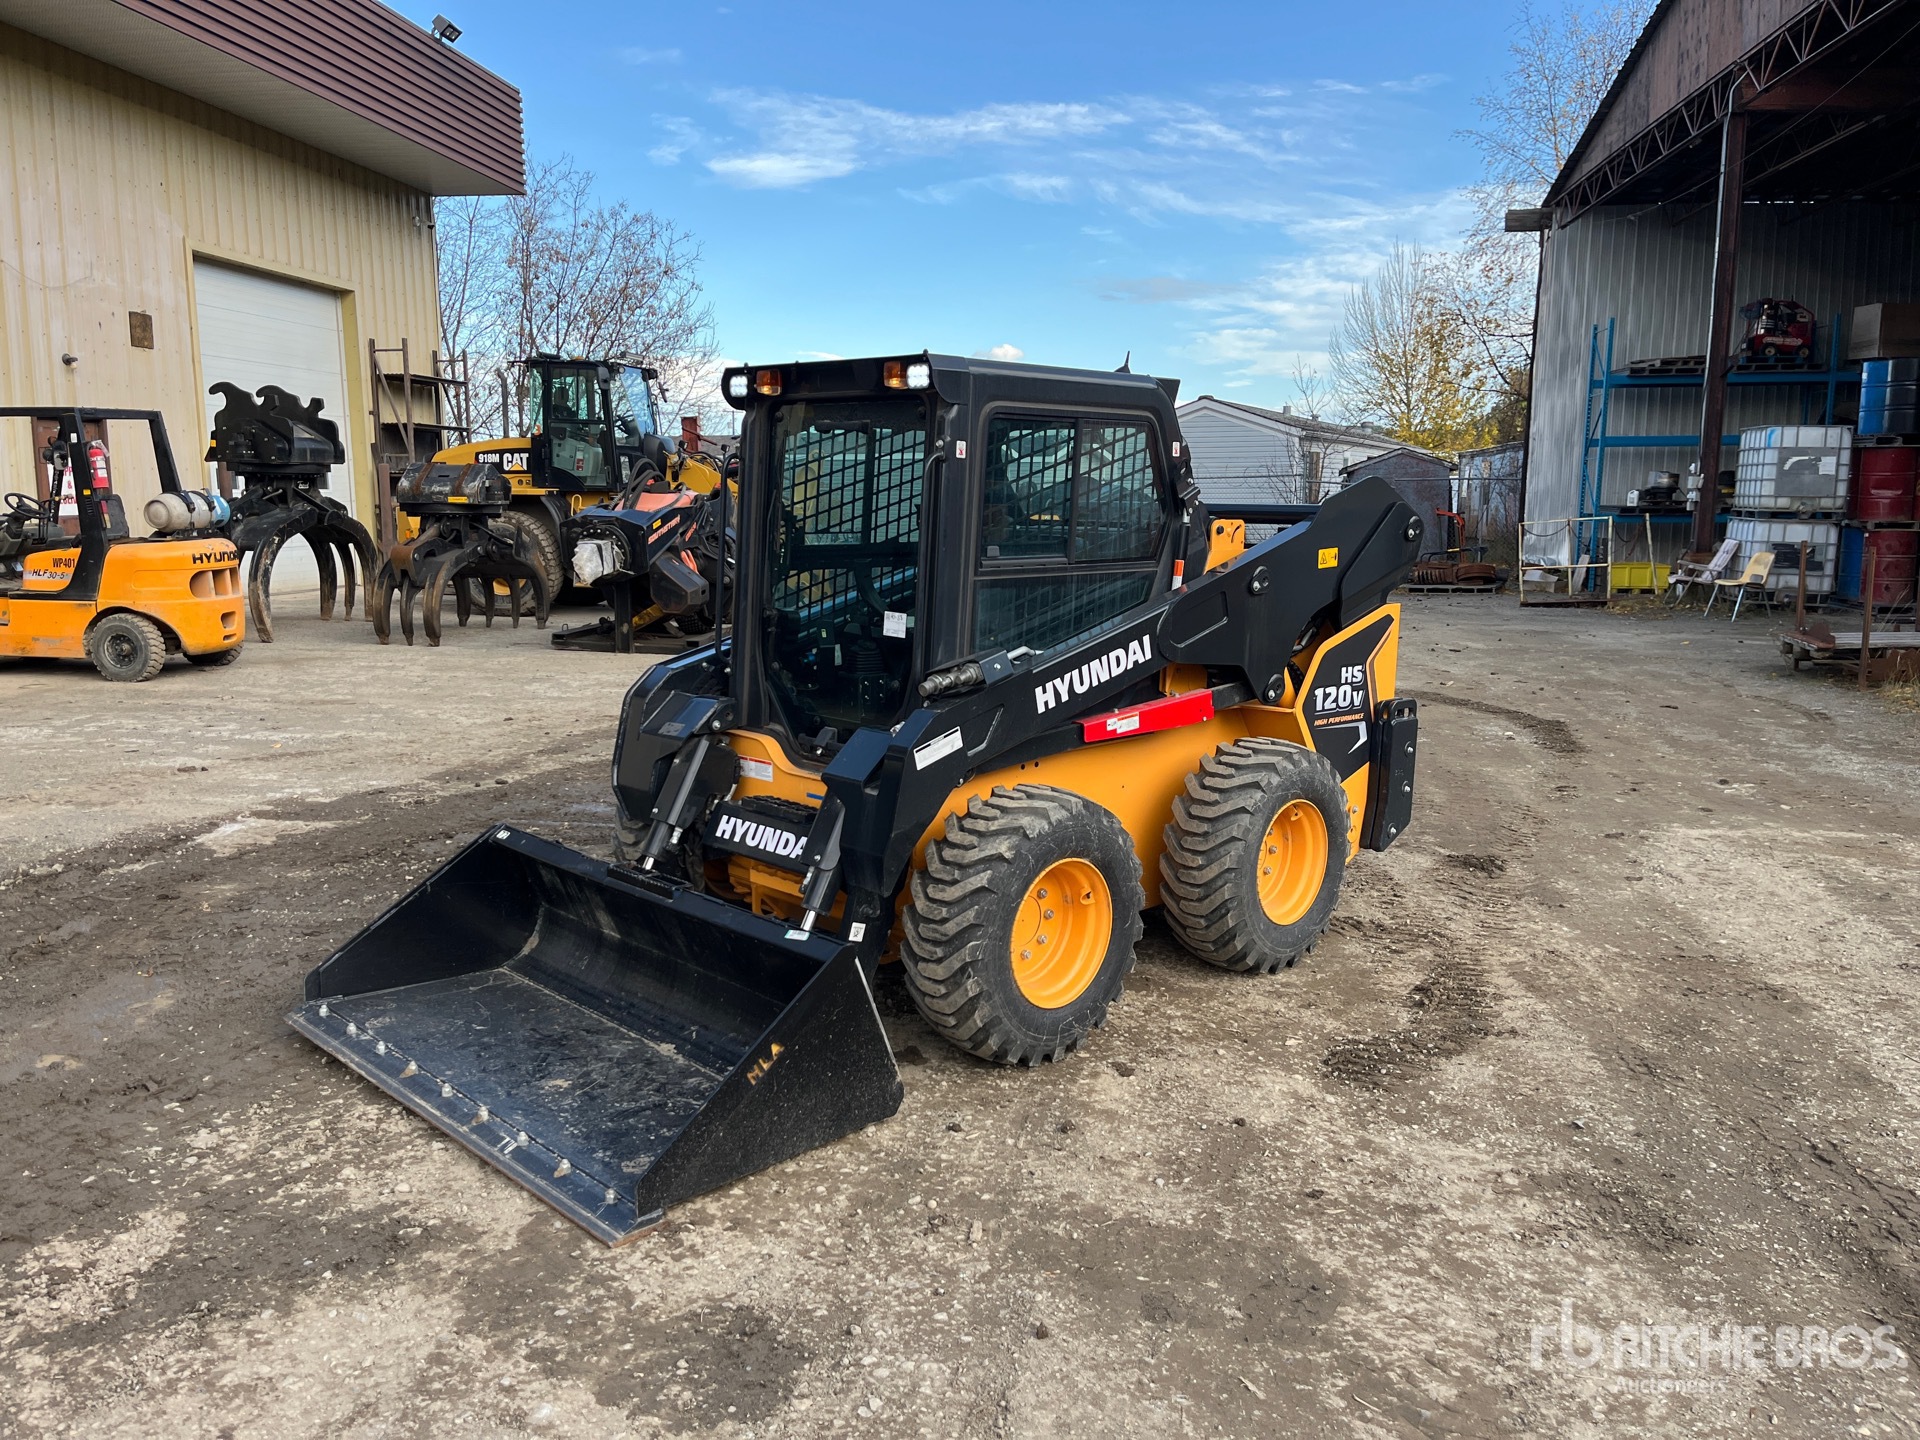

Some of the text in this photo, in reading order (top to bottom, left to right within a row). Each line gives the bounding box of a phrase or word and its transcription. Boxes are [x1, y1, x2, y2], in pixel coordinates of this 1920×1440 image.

[478, 453, 529, 471] 918M CAT
[53, 558, 75, 567] WP401
[1035, 635, 1152, 714] HYUNDAI
[1341, 665, 1364, 684] HS
[1328, 713, 1365, 724] PERFORMANCE
[715, 815, 808, 859] HYUNDA
